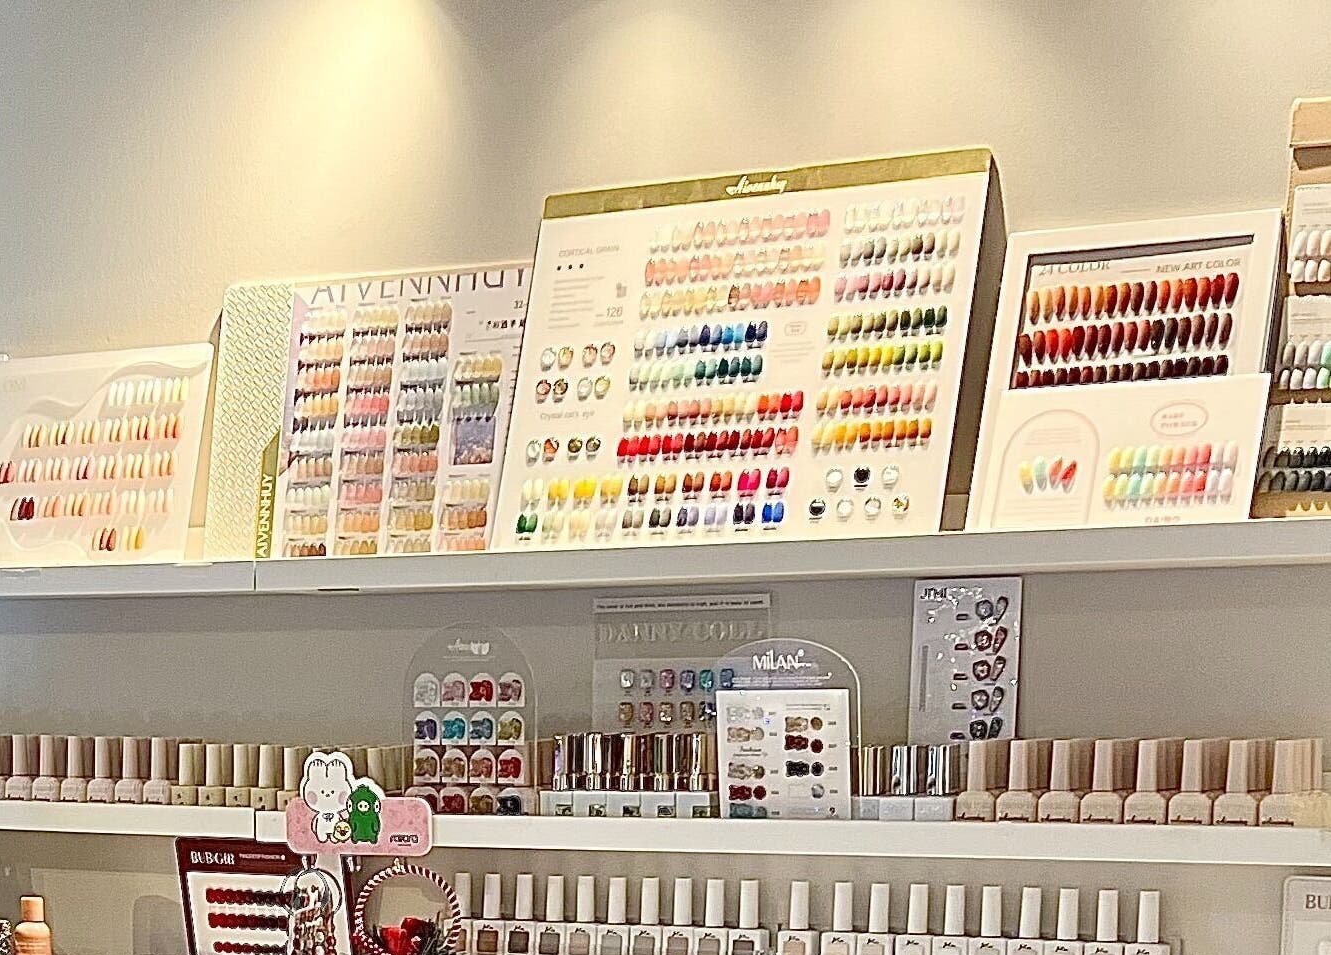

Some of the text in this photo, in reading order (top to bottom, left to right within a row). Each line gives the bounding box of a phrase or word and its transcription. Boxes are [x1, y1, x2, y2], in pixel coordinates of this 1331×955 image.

[1155, 257, 1241, 274] NEW ART COLOR
[256, 473, 275, 558] AIVENNHUY
[1305, 894, 1331, 910] BU
